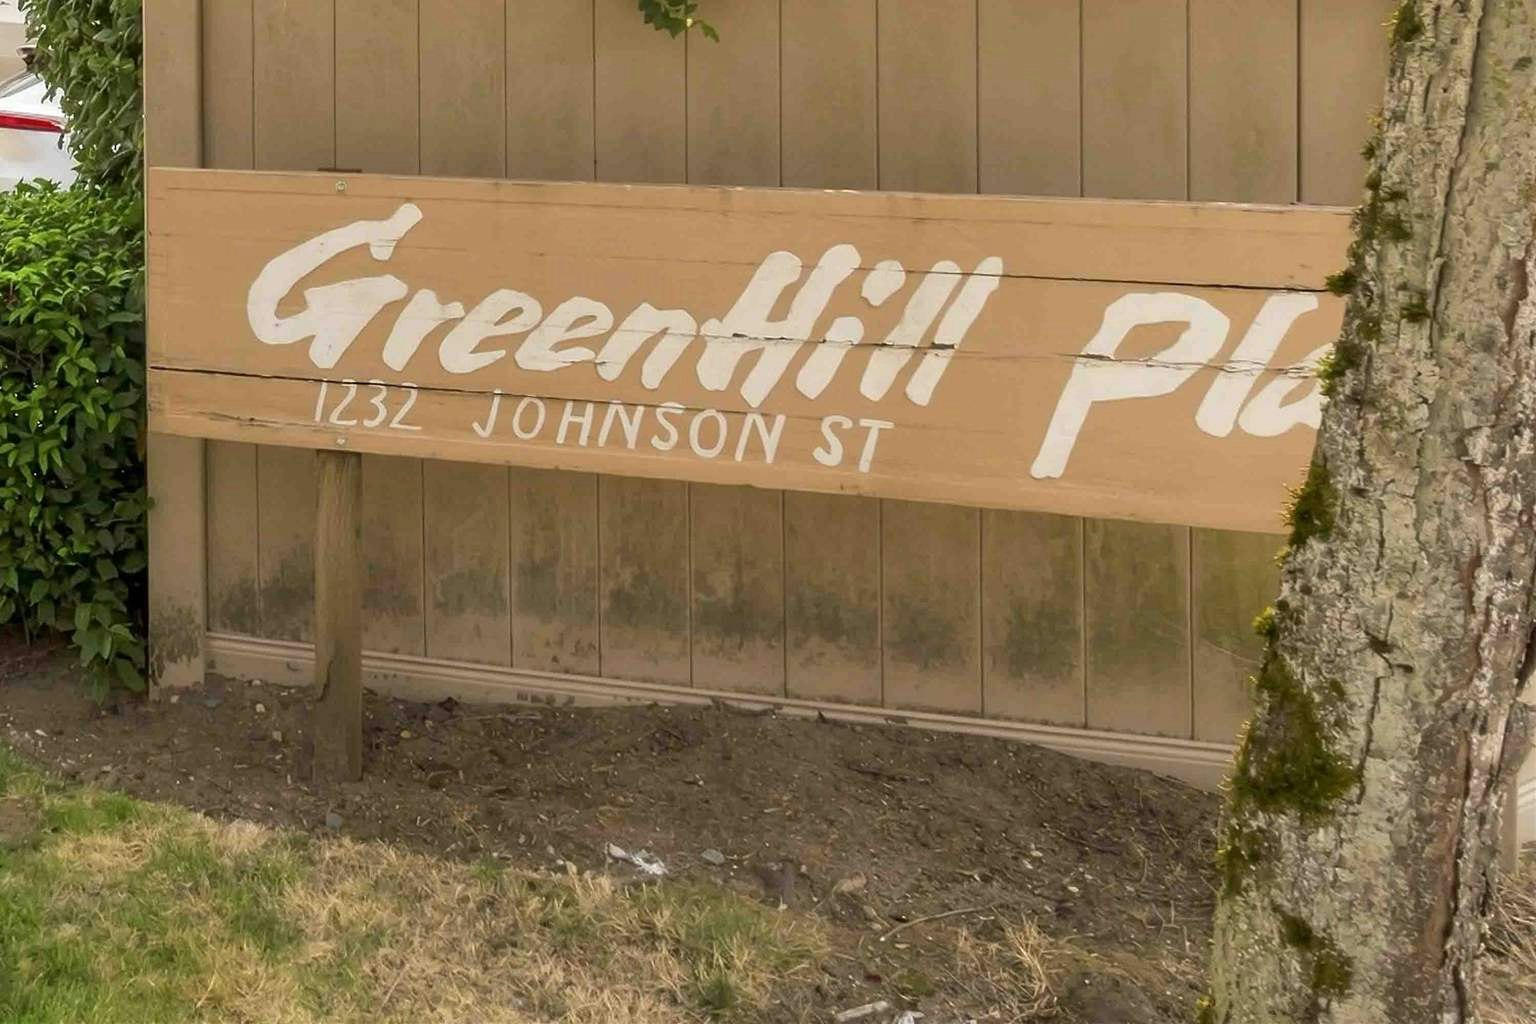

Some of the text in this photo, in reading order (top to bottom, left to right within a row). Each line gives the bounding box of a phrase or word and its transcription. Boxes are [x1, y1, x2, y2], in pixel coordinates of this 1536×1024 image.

[247, 202, 1004, 408] GreenHill
[315, 378, 895, 473] 1232 JOHNSON ST
